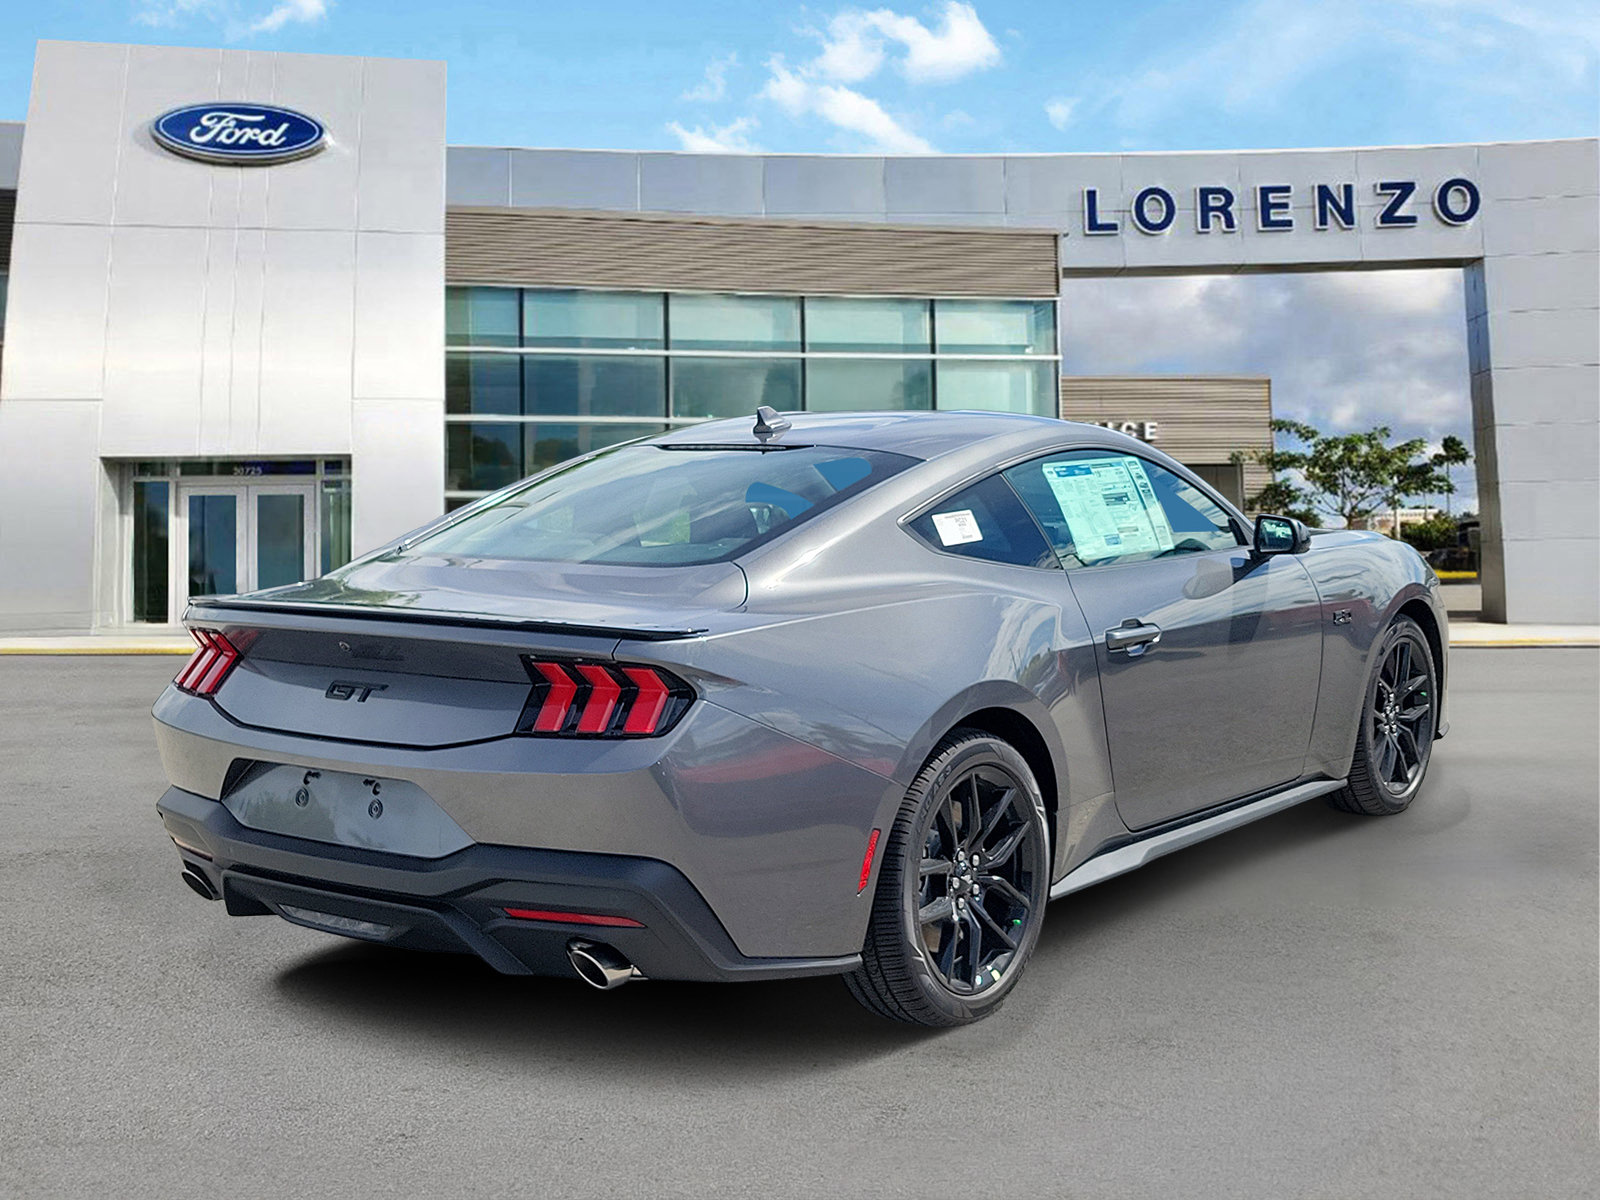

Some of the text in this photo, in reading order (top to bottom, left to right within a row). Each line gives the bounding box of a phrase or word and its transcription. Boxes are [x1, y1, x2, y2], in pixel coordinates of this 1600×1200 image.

[189, 111, 290, 146] Ford
[1083, 178, 1481, 236] LORENZO
[325, 680, 389, 703] GT
